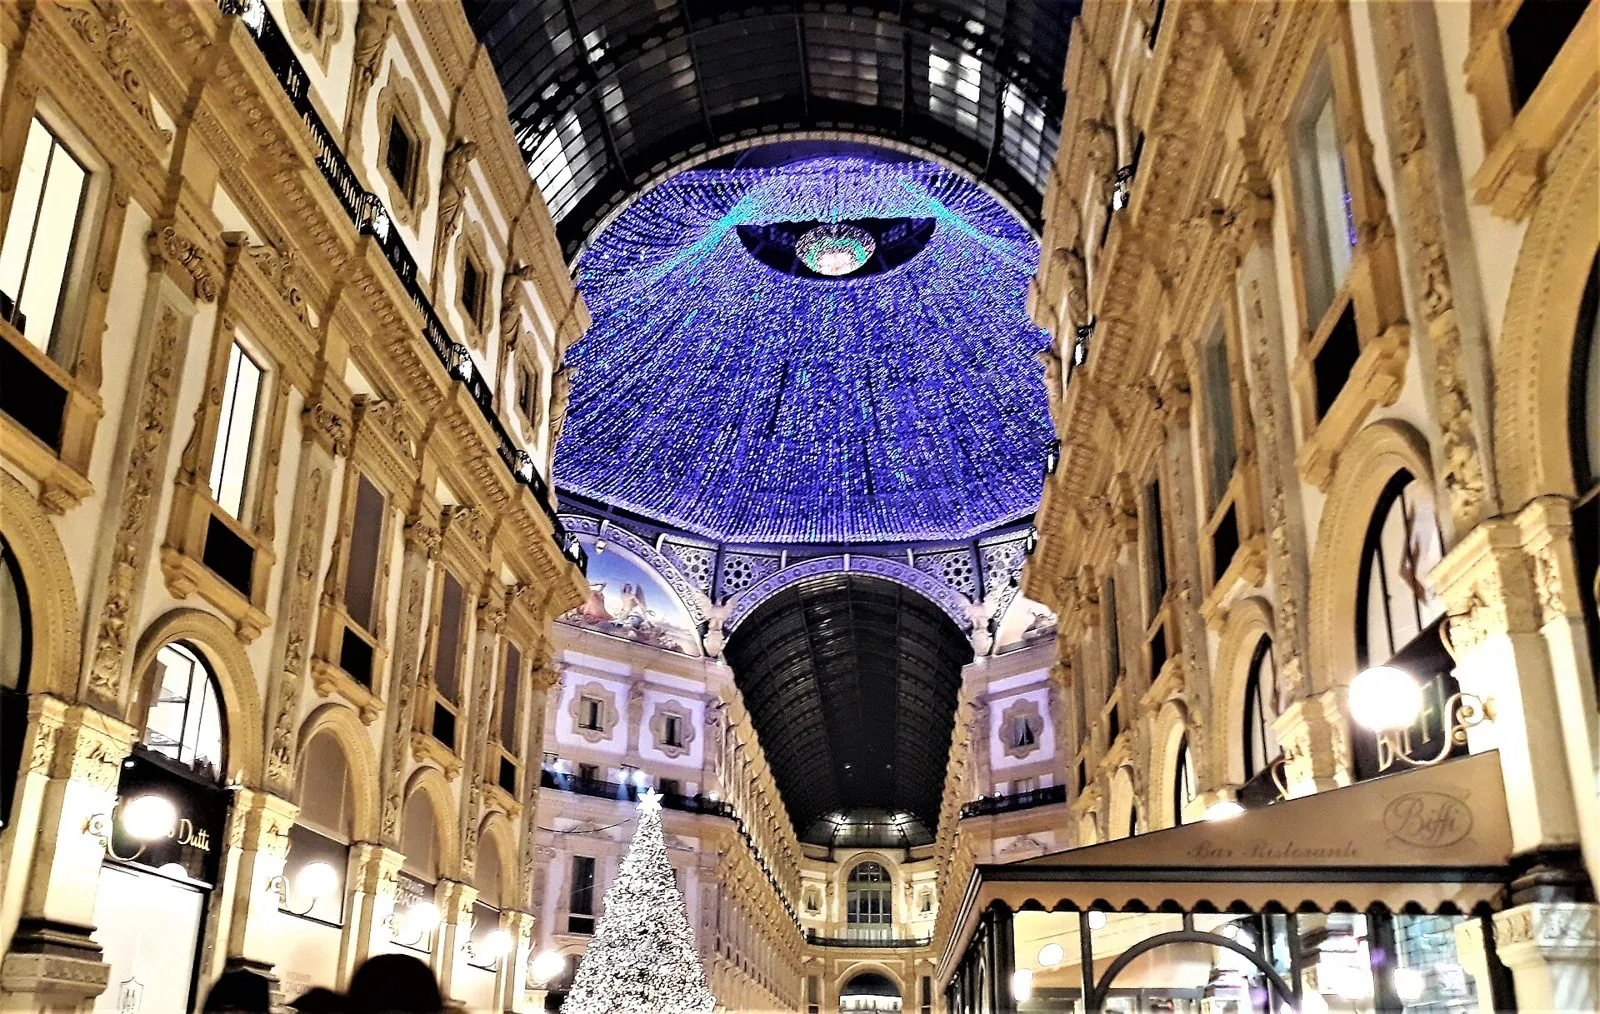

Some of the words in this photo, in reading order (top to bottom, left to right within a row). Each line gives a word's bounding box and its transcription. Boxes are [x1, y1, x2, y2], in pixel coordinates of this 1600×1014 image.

[177, 818, 211, 852] Dutti
[1393, 796, 1459, 841] Biffi
[1186, 840, 1233, 858] Bar
